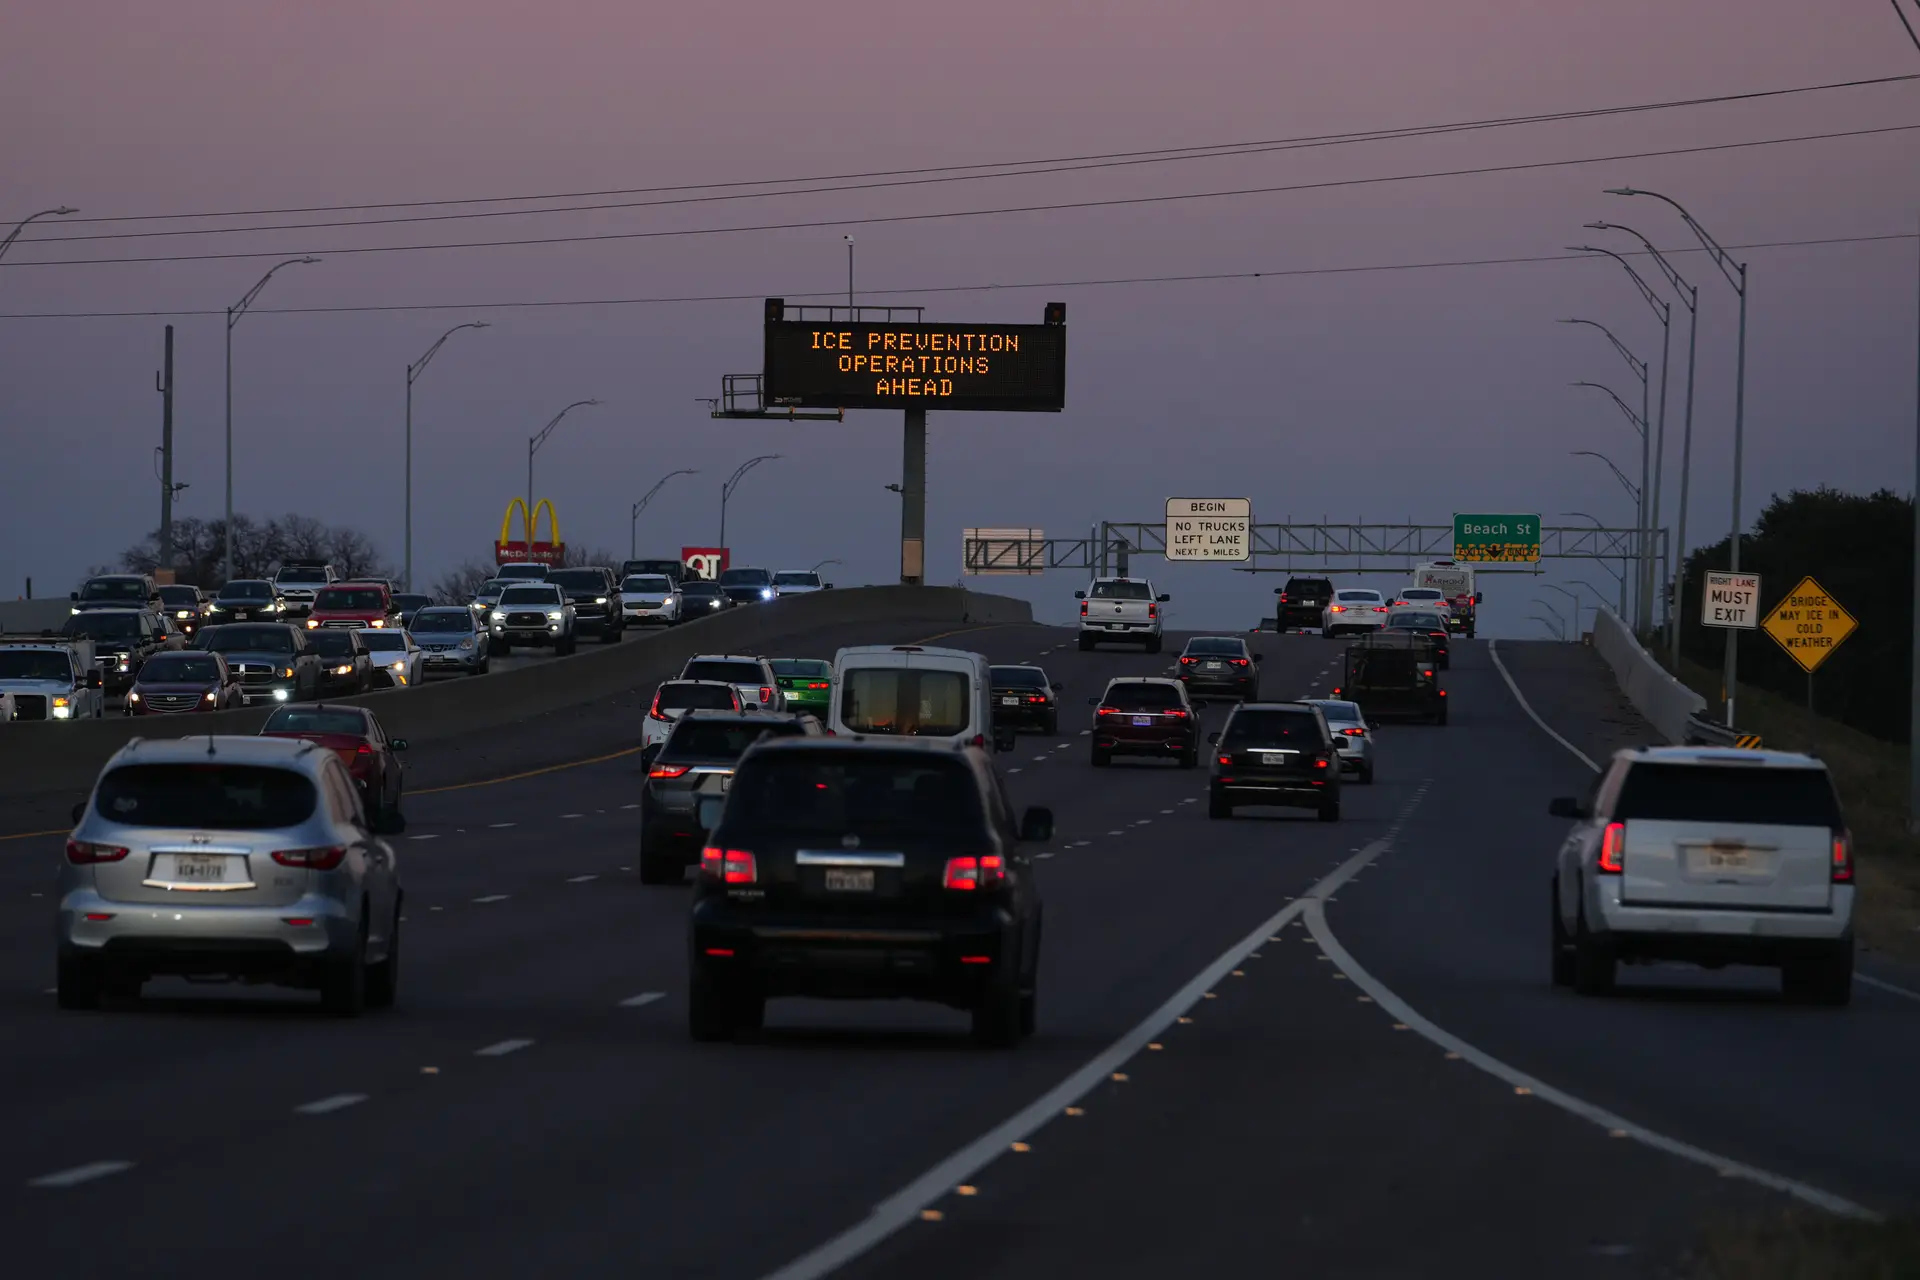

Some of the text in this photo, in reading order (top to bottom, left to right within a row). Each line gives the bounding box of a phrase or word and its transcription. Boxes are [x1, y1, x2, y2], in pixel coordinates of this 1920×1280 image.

[811, 331, 1019, 352] ICE PREVENTION
[838, 355, 989, 374] OPERATIONS
[876, 378, 953, 396] AHEAD
[1190, 502, 1226, 512] BEGIN
[1175, 522, 1245, 531] NO TRUCKS
[1463, 523, 1531, 535] Beach St
[1174, 535, 1241, 544] LEFT LANE
[1175, 548, 1240, 556] NEXT 5 MILES
[685, 554, 721, 581] QT
[1709, 576, 1756, 588] RIGHT LANE
[1711, 589, 1752, 605] MUST
[1790, 595, 1828, 607] BRIDGE
[1714, 608, 1746, 622] EXIT
[1779, 609, 1839, 621] MAY ICE IN
[1796, 623, 1823, 634] COLD
[1786, 637, 1833, 648] WEATHER
